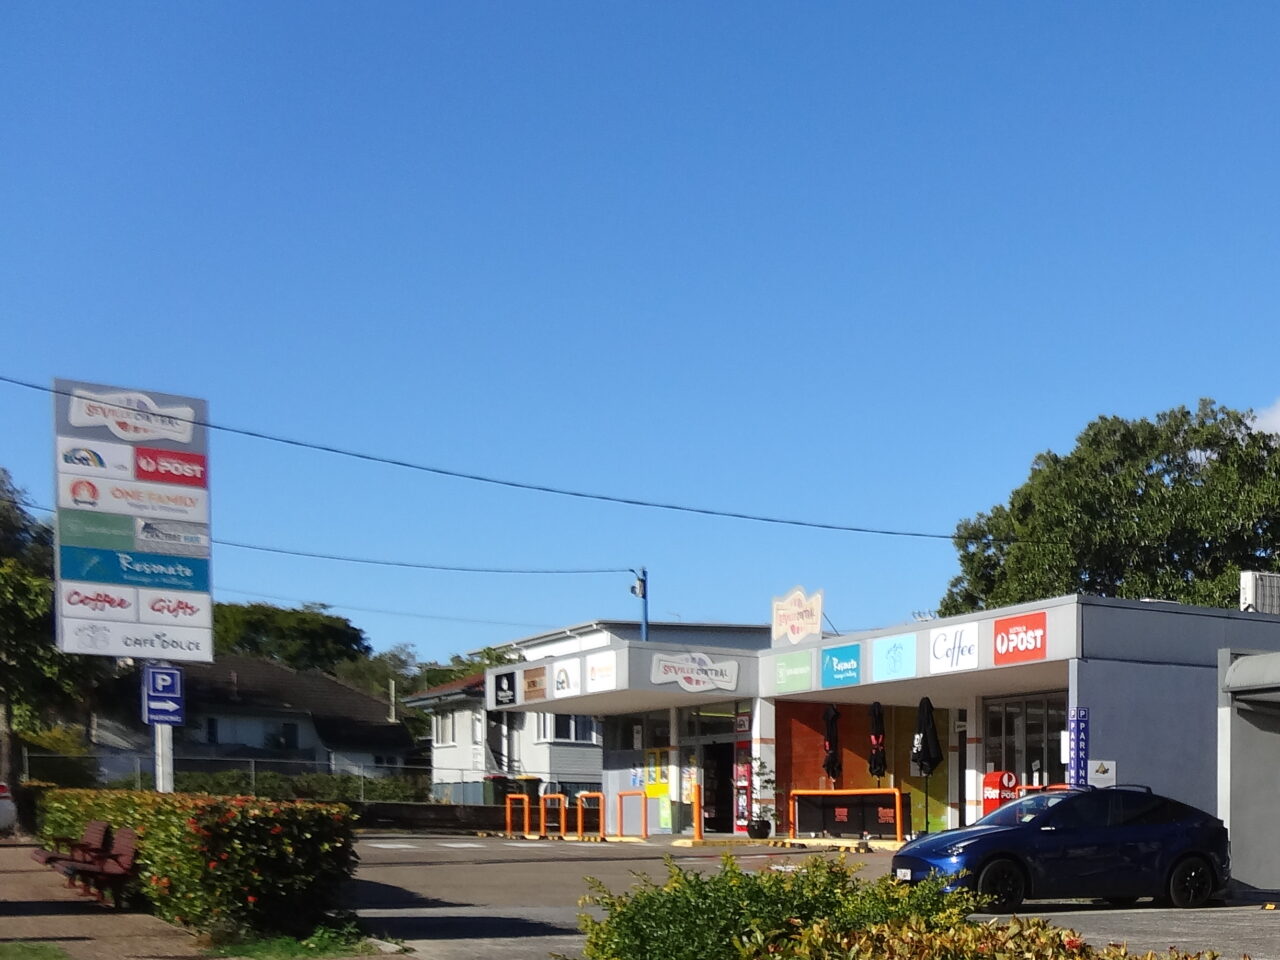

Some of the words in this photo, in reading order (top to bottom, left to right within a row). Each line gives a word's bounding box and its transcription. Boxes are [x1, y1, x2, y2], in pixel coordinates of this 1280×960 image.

[158, 462, 205, 479] POST
[67, 589, 132, 610] Coffee
[150, 598, 200, 616] Gifts
[122, 636, 155, 649] CAFE
[161, 639, 201, 651] DOLCE
[932, 629, 977, 667] Coffee
[1008, 628, 1045, 653] POST
[663, 664, 696, 676] SEVILLE
[155, 673, 172, 691] P
